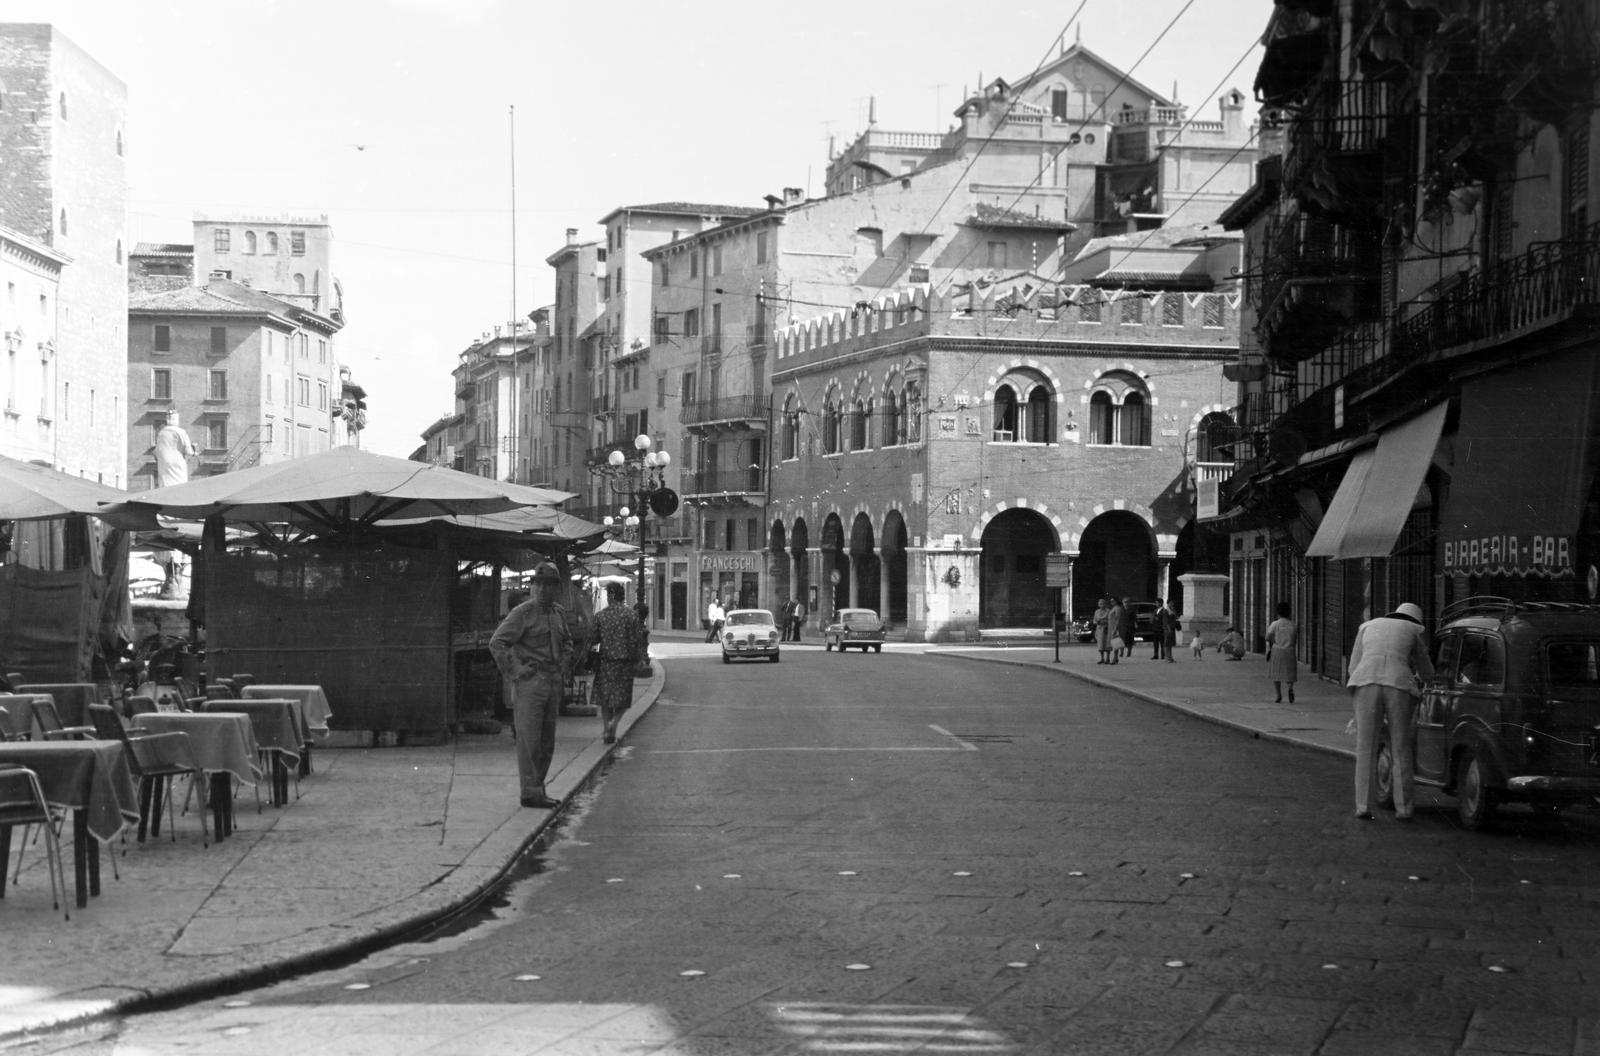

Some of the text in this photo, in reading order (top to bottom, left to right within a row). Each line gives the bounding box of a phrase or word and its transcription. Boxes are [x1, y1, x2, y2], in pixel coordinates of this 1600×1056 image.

[702, 555, 754, 569] FRANCESCHI
[1444, 535, 1518, 567] BIRRERIA
[1533, 535, 1570, 567] BAR
